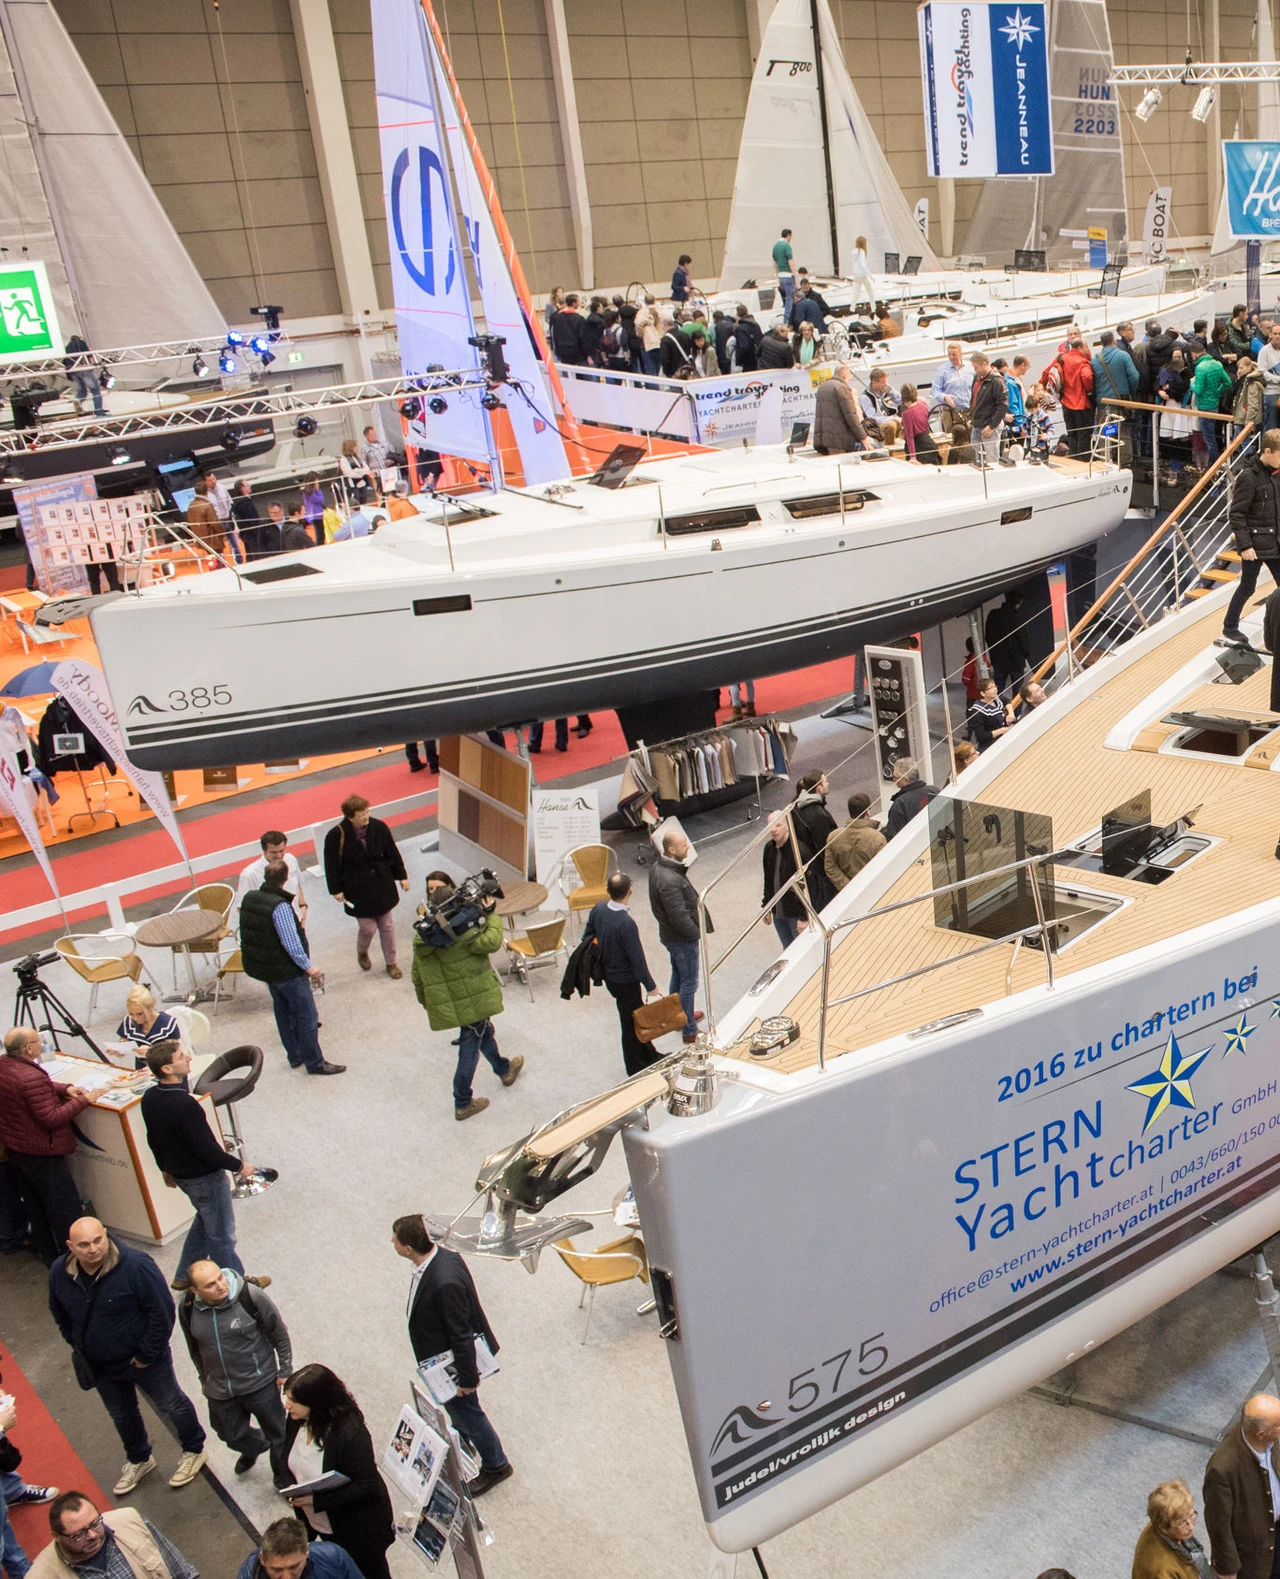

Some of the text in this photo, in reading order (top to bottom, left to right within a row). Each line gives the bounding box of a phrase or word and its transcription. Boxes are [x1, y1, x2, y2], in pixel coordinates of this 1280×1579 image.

[954, 49, 968, 166] trend travel
[1016, 54, 1029, 165] JEANNEAU
[1074, 118, 1115, 135] 2203
[1078, 85, 1110, 100] HUN
[1152, 194, 1168, 238] BOAT
[695, 388, 732, 400] trend
[168, 684, 233, 712] 385
[537, 797, 569, 813] Hanse
[997, 966, 1258, 1103] 2016 zu chartern bei
[955, 1099, 1102, 1205] STERN
[955, 1079, 1277, 1253] Yachtcharter GmbH
[929, 1184, 1155, 1314] office@stern-yachtcharter.at
[1170, 1122, 1266, 1189] 0043/660/150
[1010, 1154, 1243, 1294] www.stern-yachtcharter.at
[788, 1332, 889, 1413] 575
[724, 1391, 906, 1501] judel/vrolijk design
